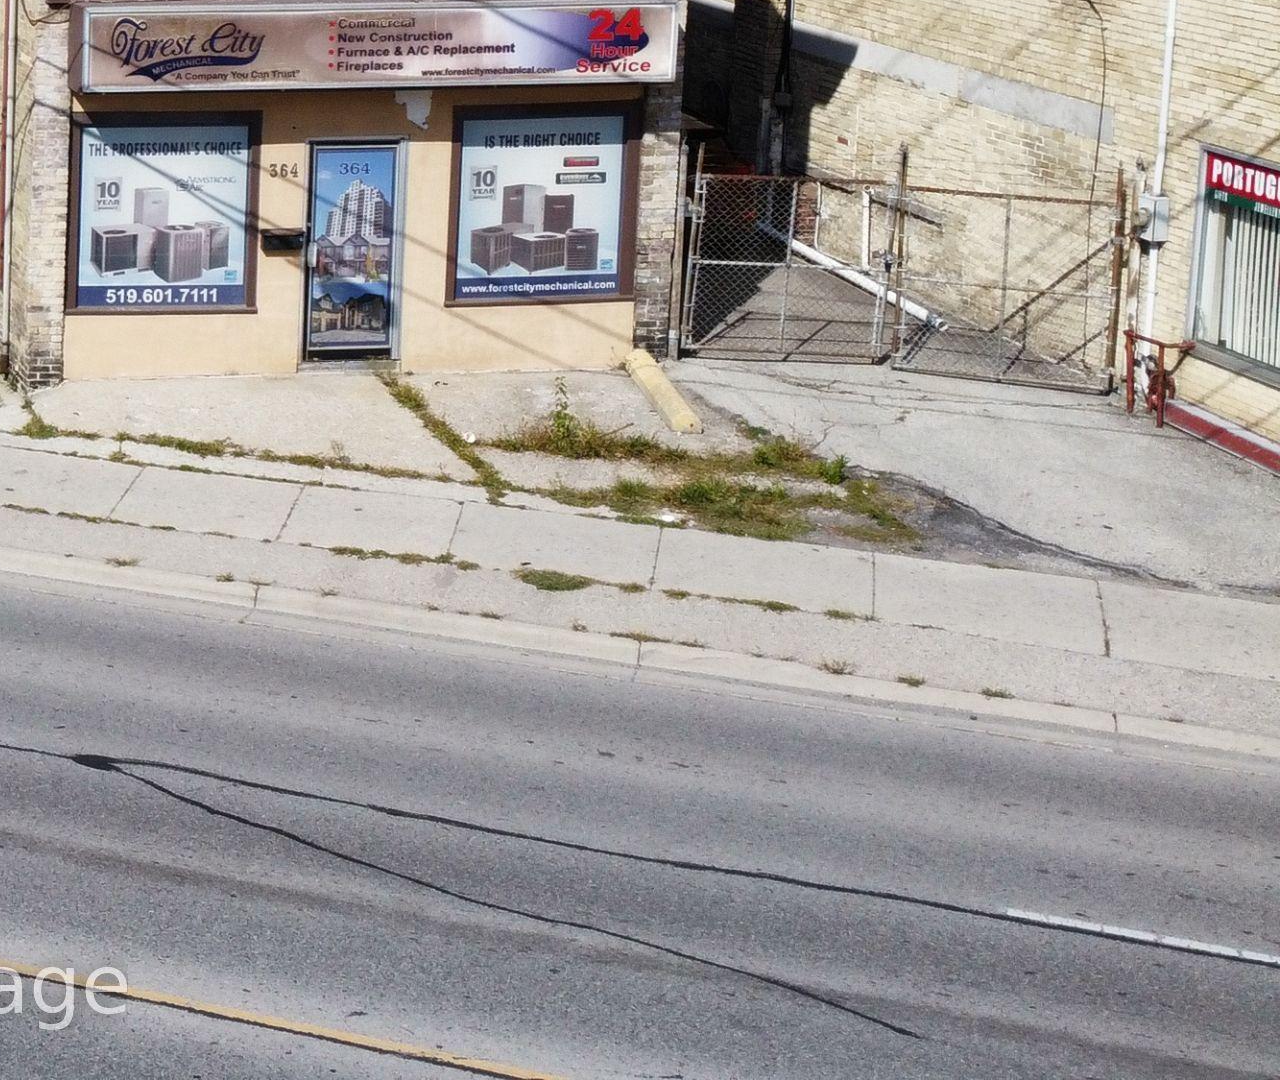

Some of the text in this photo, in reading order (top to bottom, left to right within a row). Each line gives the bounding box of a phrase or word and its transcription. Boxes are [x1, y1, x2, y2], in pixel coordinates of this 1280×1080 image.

[338, 17, 416, 29] Commercial
[587, 7, 644, 41] 24
[111, 17, 266, 68] Forest City
[337, 30, 453, 43] New Construction
[337, 43, 515, 58] Furnace & A/C Replacement
[591, 44, 638, 58] Hour
[151, 57, 213, 75] MECHANICAL
[337, 60, 404, 72] Fireplaces
[421, 66, 556, 77] www.forestcitymechanical.com
[575, 58, 651, 74] Service
[185, 72, 228, 82] Company
[231, 71, 248, 79] You
[251, 70, 269, 79] Can
[484, 132, 601, 148] IS THE RIGHT CHOICE
[88, 140, 242, 157] THE PROFESSIONAL'S CHOICE
[269, 162, 299, 178] 364
[339, 162, 371, 175] 364
[472, 170, 496, 187] 10
[1211, 158, 1280, 202] PORTUG
[96, 181, 121, 198] 10
[461, 280, 616, 294] www.forestcitymechanical.com
[105, 287, 218, 304] 519.601.7111
